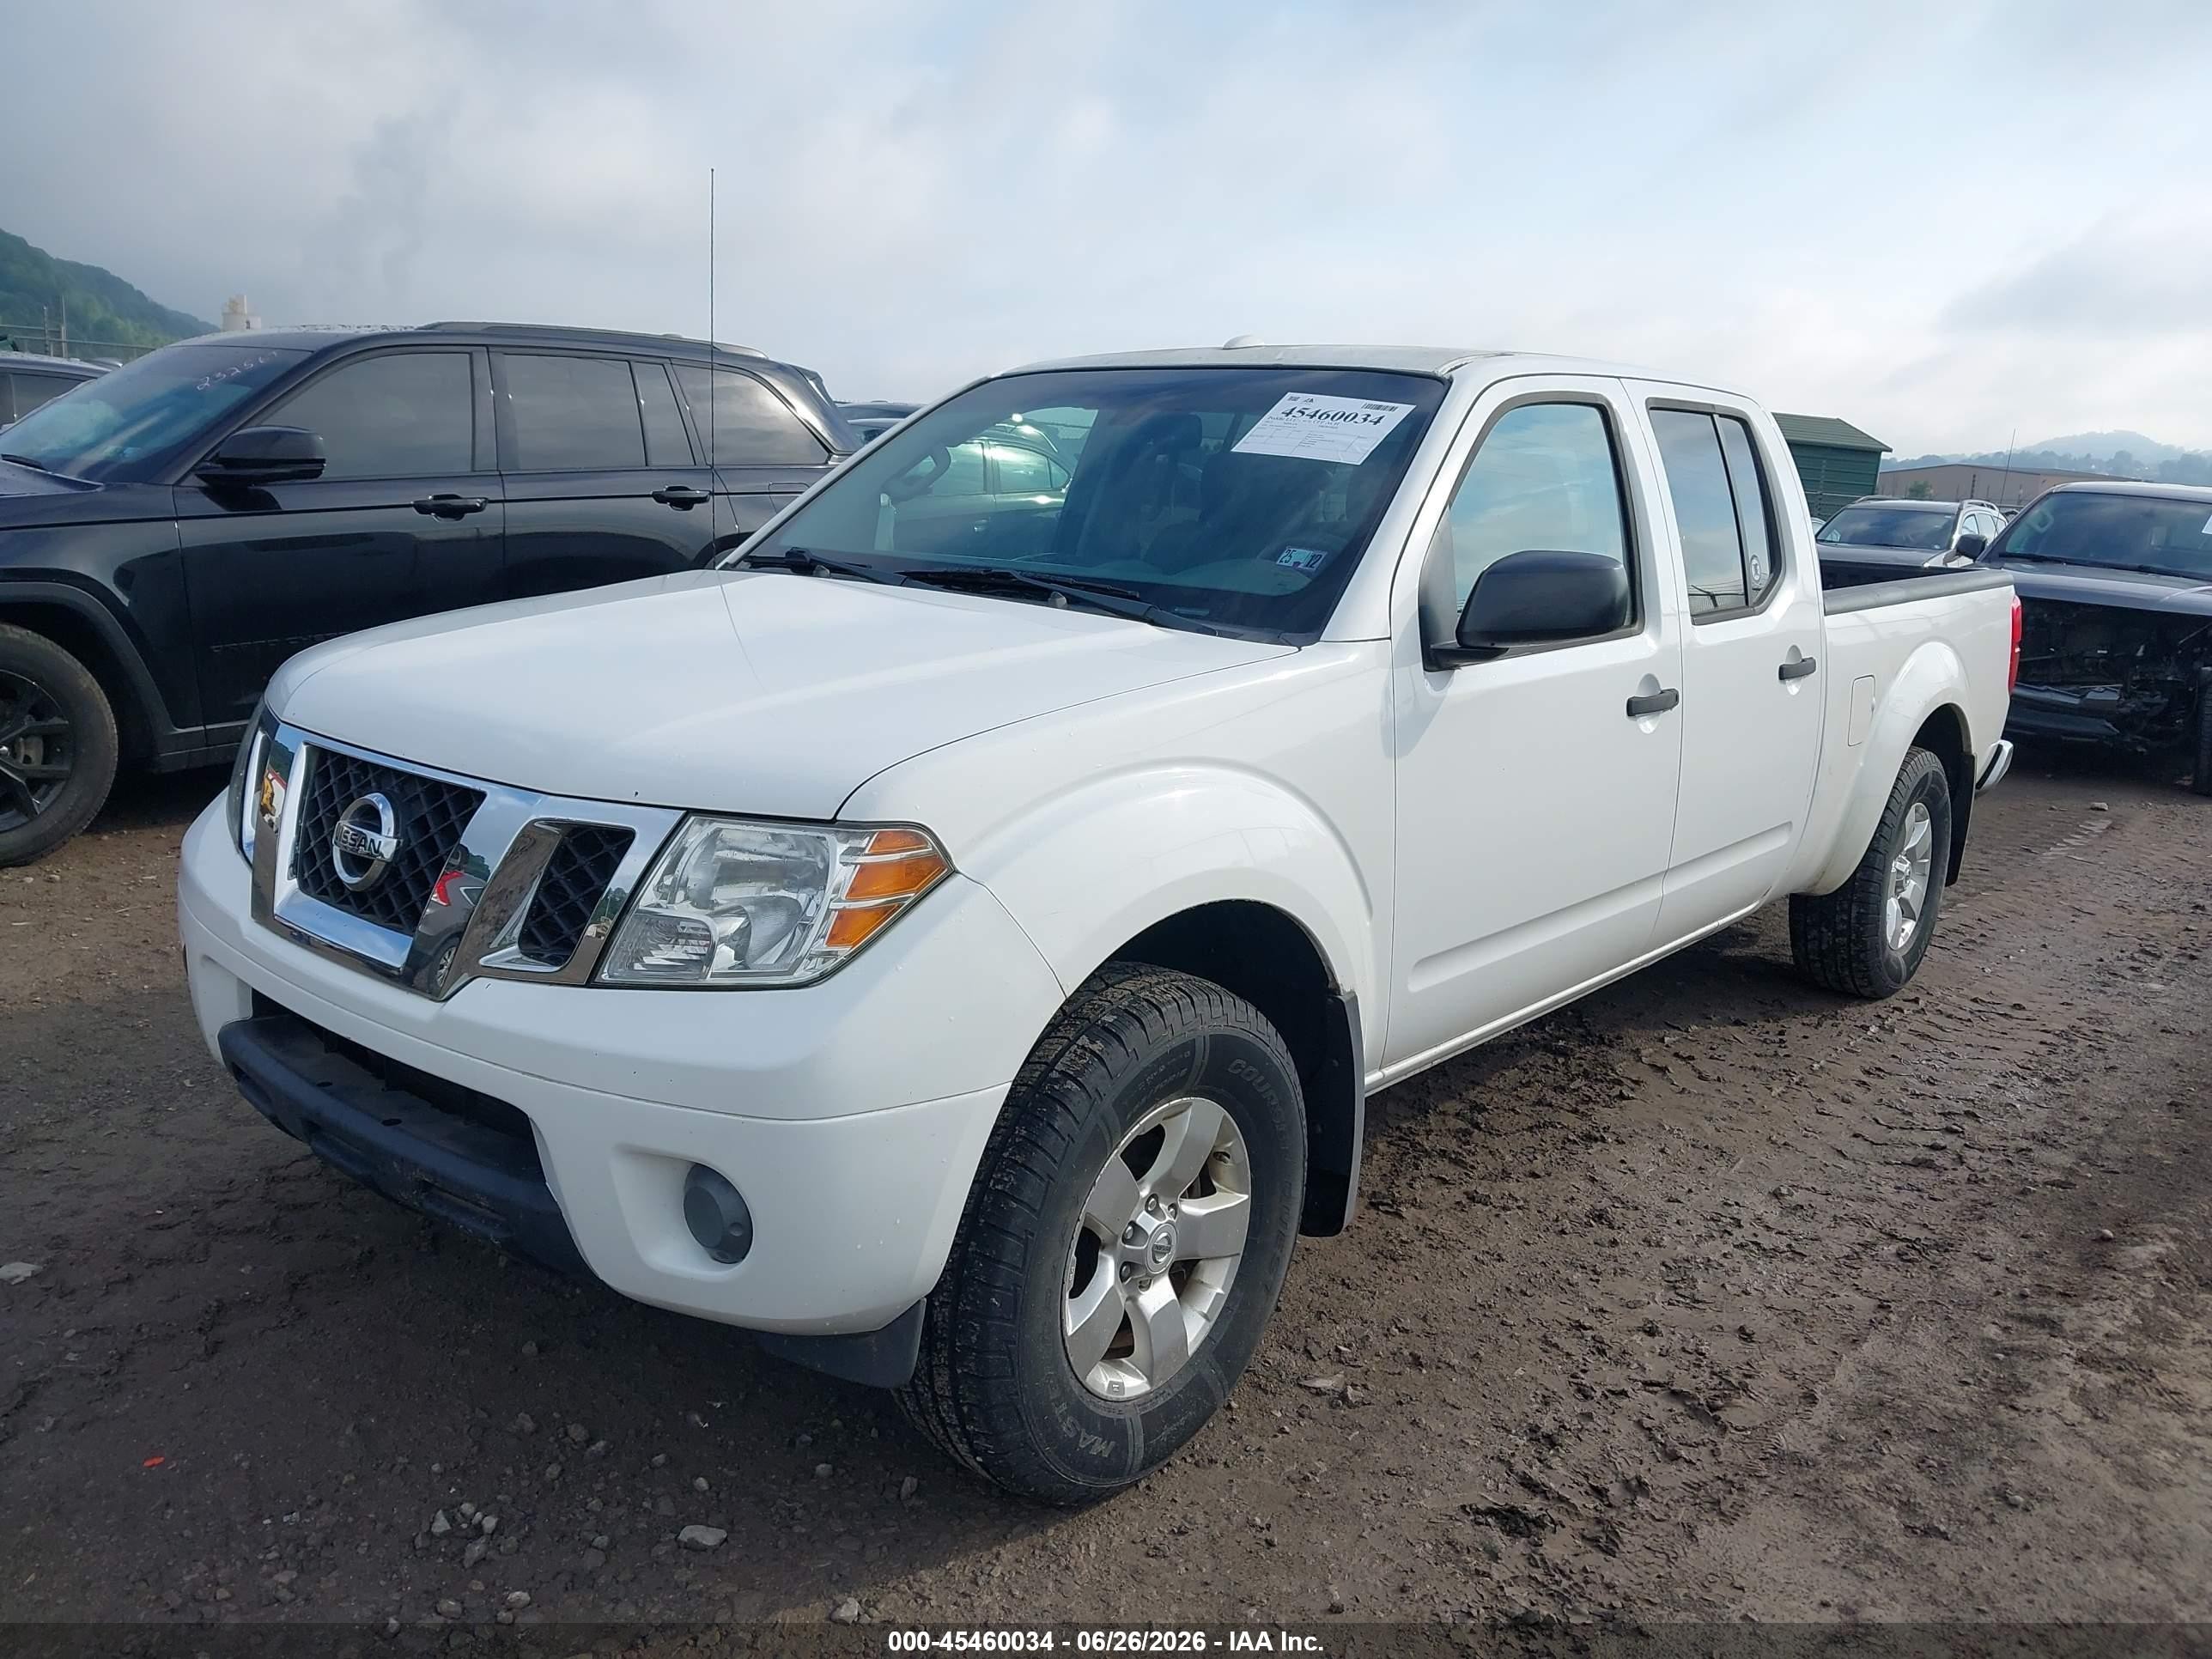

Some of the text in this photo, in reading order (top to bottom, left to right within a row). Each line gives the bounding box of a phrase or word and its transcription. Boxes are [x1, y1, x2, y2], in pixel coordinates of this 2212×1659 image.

[1281, 405, 1386, 426] 45460034
[1279, 549, 1322, 569] 25 12
[335, 824, 383, 854] NISSAN
